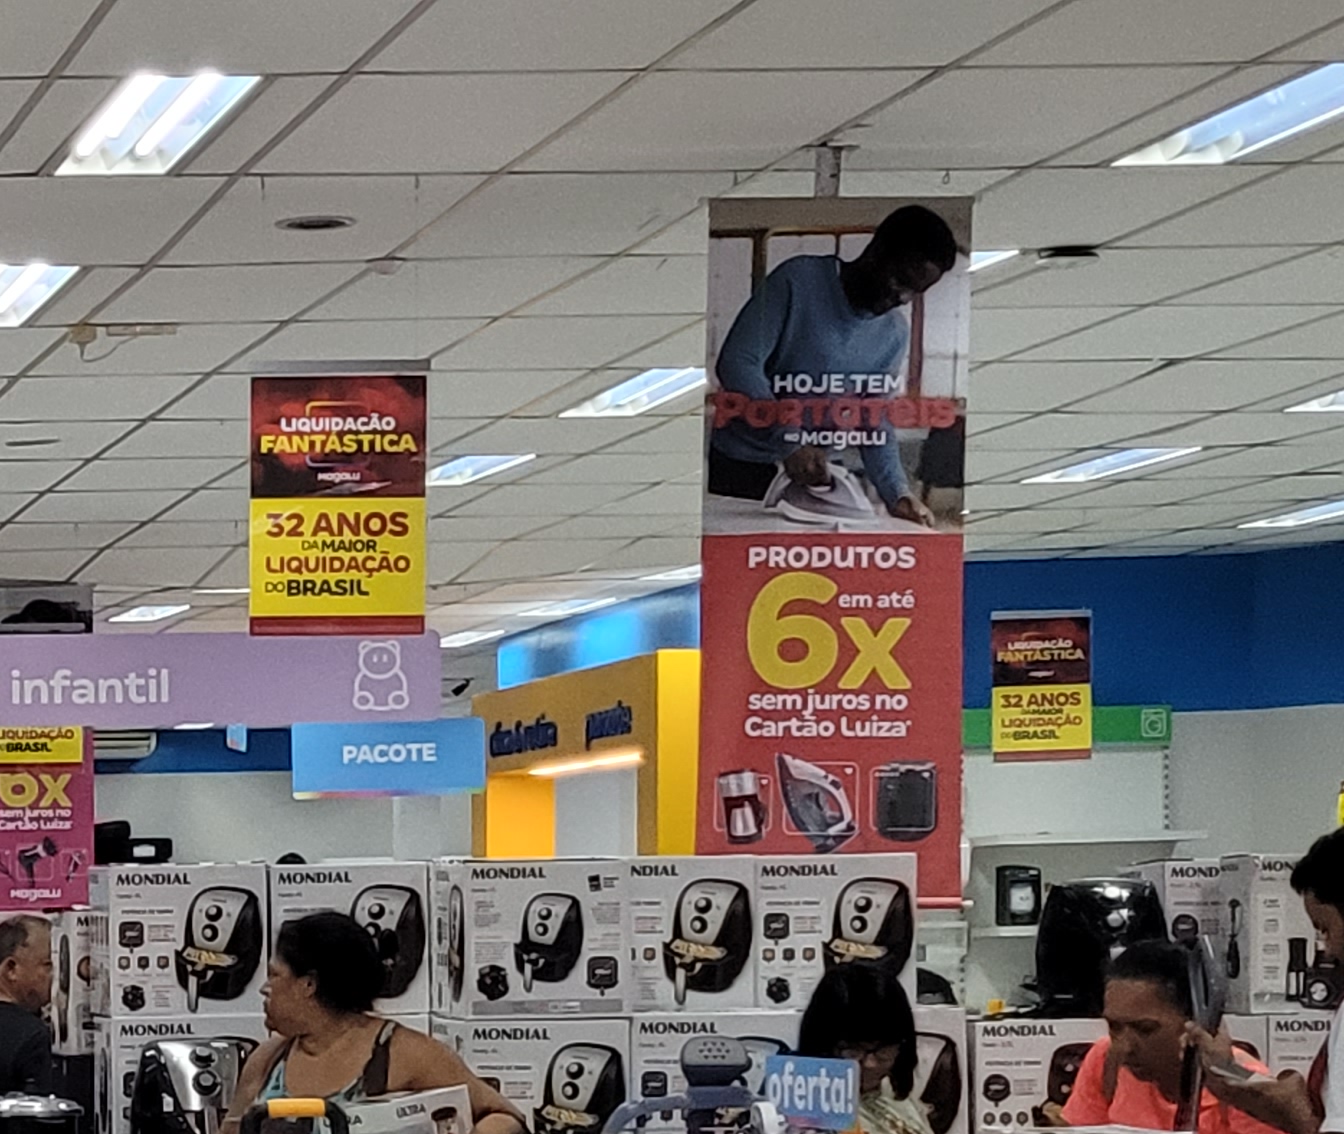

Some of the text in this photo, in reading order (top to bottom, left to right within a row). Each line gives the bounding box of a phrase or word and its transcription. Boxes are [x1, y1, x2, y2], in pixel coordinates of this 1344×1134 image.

[773, 373, 906, 394] HOJE TEM
[280, 413, 396, 433] LIQUIDAÇÃO
[260, 430, 418, 454] FANTÁSTICA
[265, 511, 410, 538] 32 ANOS
[301, 539, 377, 553] DA MAIOR
[265, 550, 411, 578] LIQUIDAÇÃO
[748, 546, 917, 569] PRODUTOS
[265, 579, 370, 597] DO BRASIL
[838, 589, 915, 609] em até
[10, 667, 170, 705] infantil
[748, 688, 909, 717] sem juros no
[1000, 691, 1082, 709] 32 ANOS
[744, 715, 836, 738] Cartão
[342, 742, 438, 765] PACOTE
[116, 872, 191, 886] MONDIAL
[277, 871, 353, 886] MONDIAL
[470, 864, 547, 880] MONDIAL
[760, 864, 839, 879] MONDIAL
[120, 1023, 195, 1037] MONDIAL
[472, 1026, 551, 1042] MONDIAL
[639, 1021, 718, 1035] MONDIAL
[981, 1024, 1057, 1038] MONDIAL
[767, 1061, 855, 1114] oferta!
